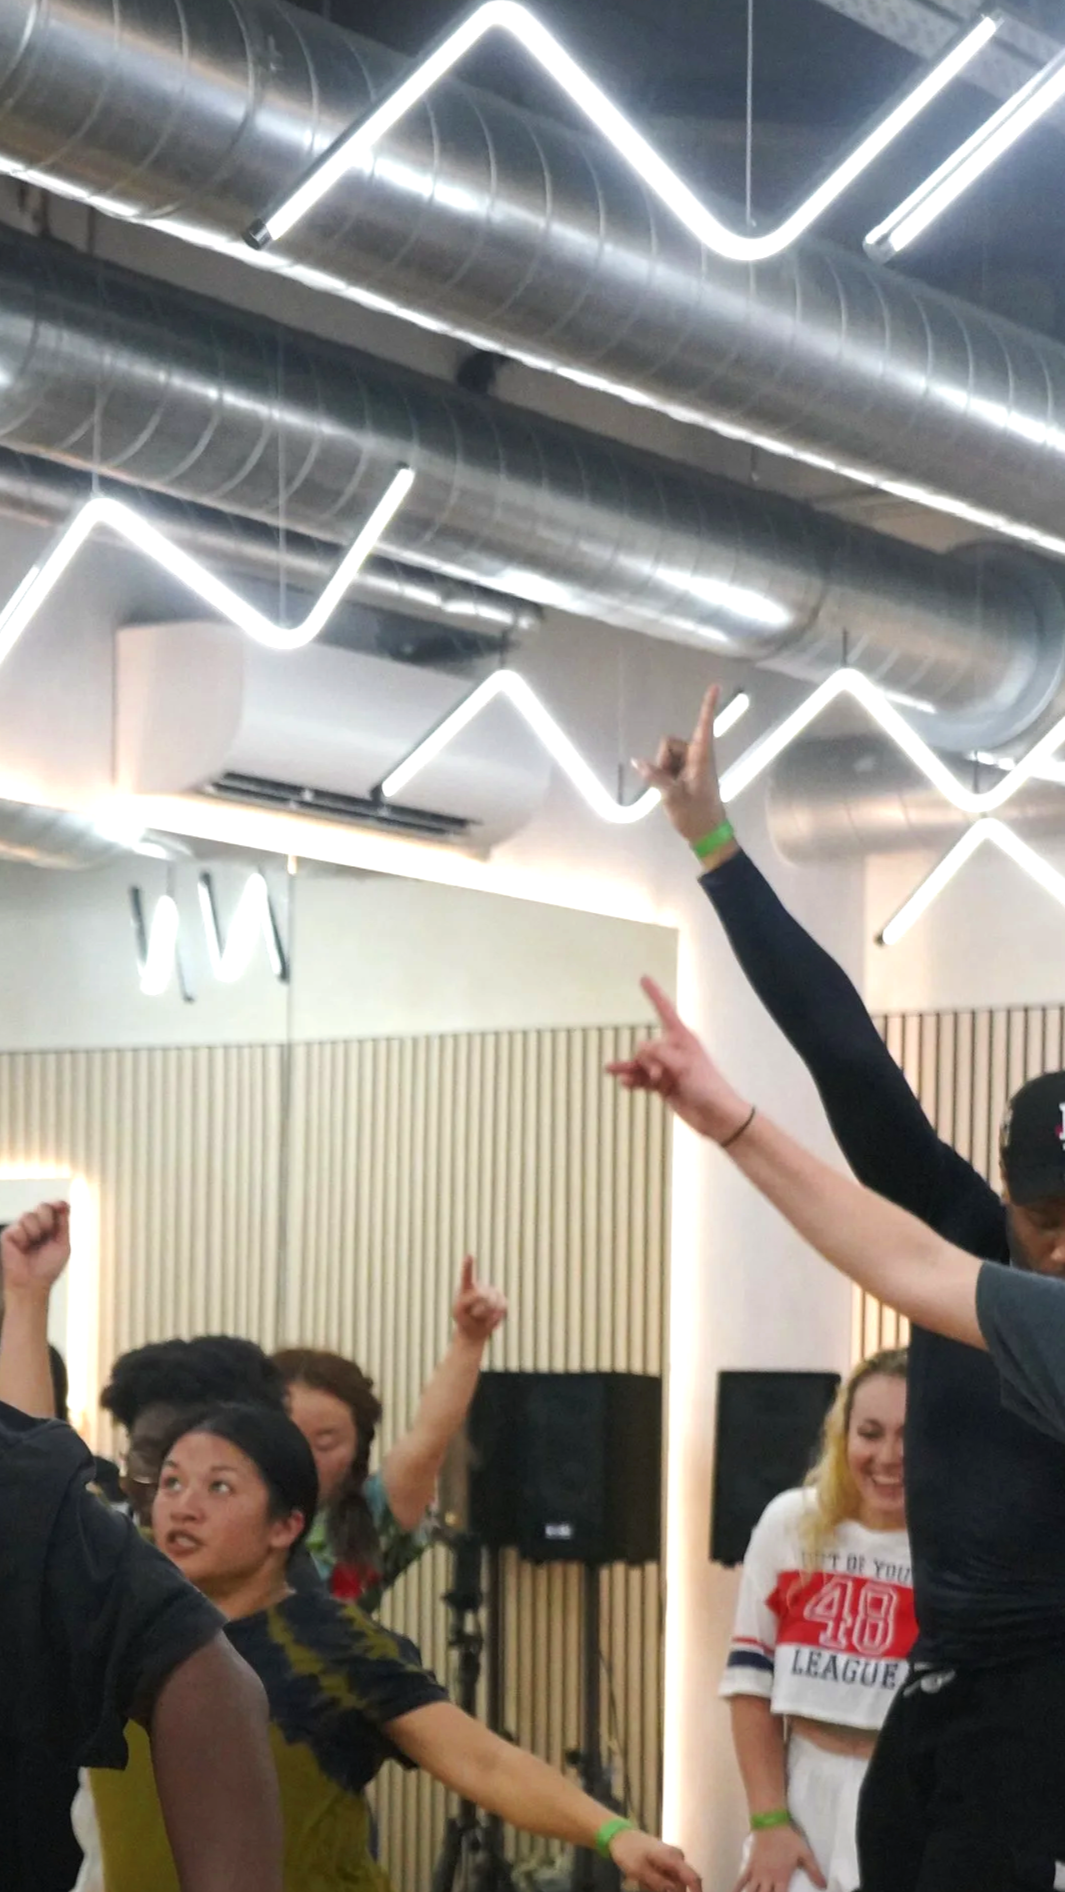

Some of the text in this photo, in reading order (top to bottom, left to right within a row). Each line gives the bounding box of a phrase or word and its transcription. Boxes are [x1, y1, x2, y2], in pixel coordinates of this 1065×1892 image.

[847, 1553, 865, 1575] OF
[803, 1576, 897, 1655] 48
[791, 1649, 899, 1690] LEAGUE
